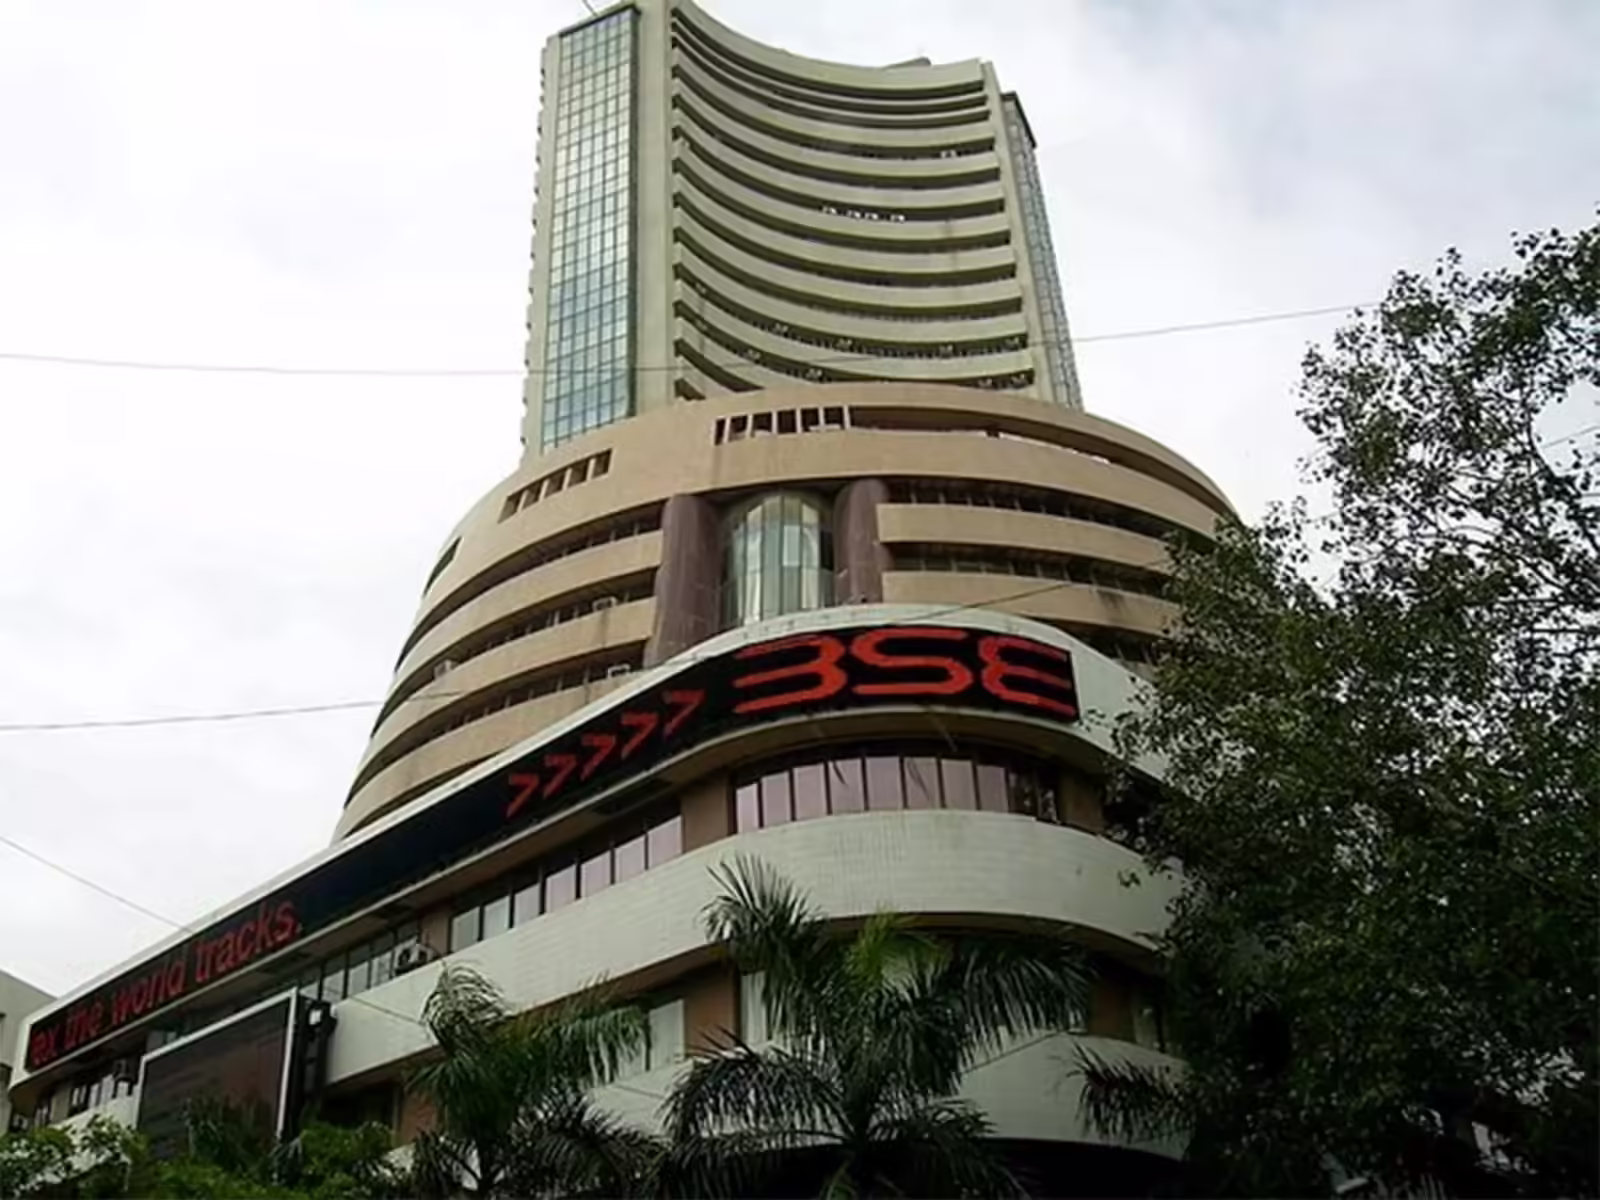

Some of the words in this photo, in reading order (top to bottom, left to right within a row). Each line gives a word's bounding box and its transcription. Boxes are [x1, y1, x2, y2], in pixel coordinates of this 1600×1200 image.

[733, 627, 1077, 717] BSE
[64, 992, 105, 1050] the
[111, 944, 187, 1026] world
[191, 900, 303, 983] tracks.
